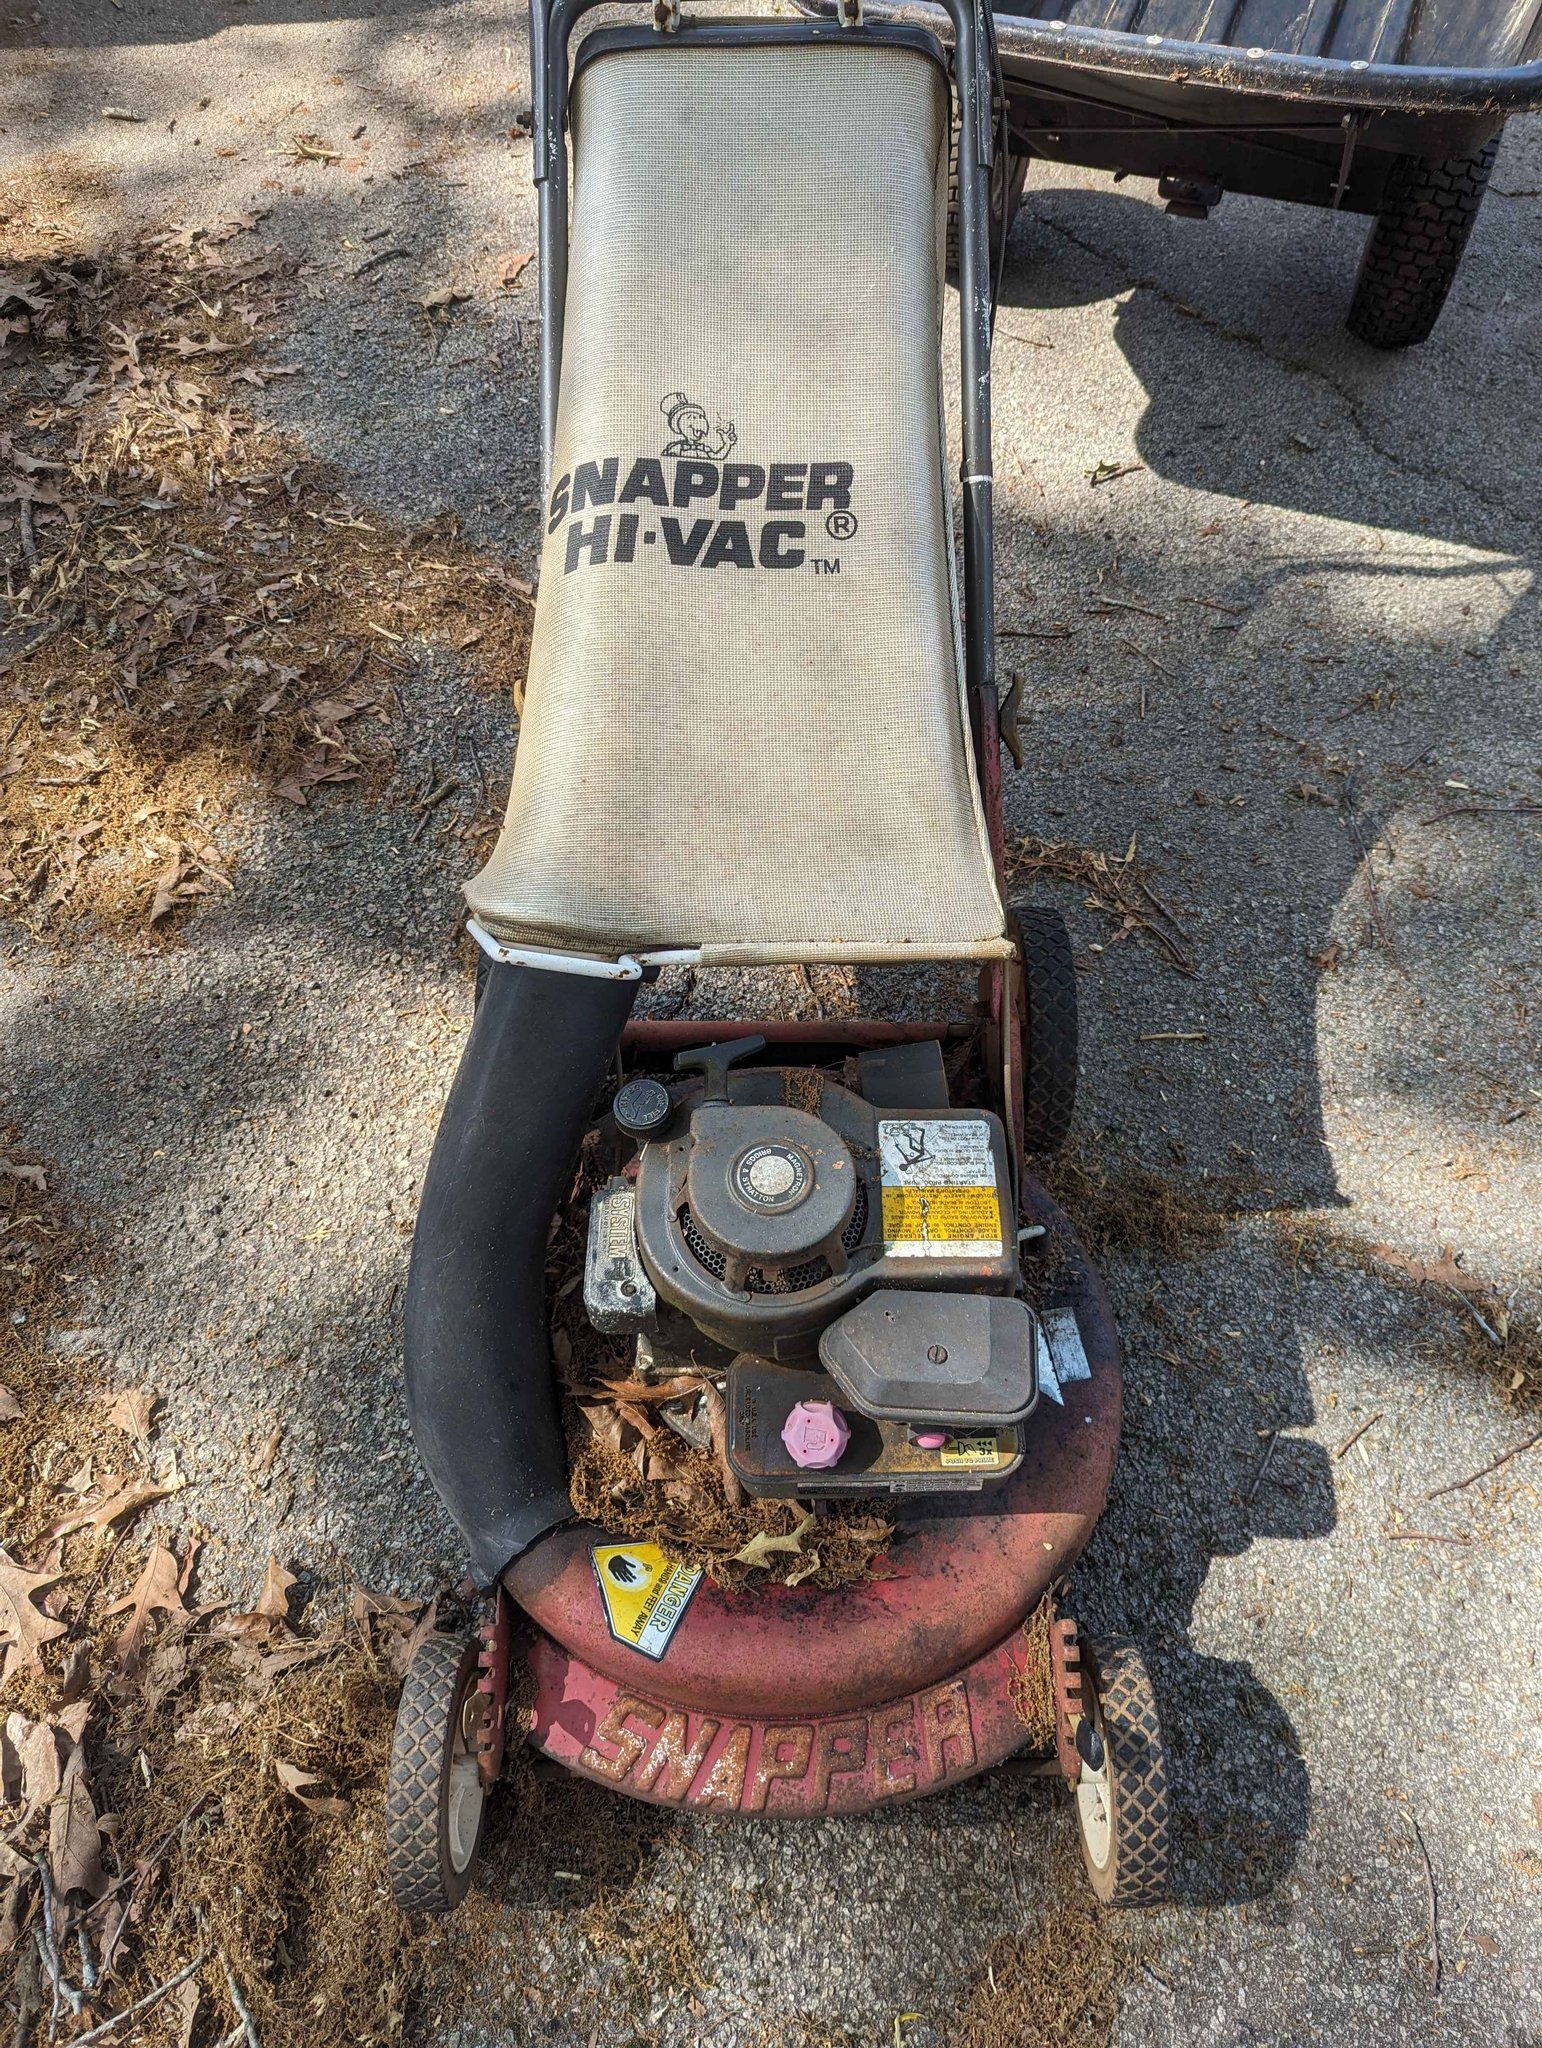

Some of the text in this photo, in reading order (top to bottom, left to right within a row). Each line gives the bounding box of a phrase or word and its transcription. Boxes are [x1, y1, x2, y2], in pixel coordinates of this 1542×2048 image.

[549, 457, 854, 535] SNAPPER
[642, 1107, 661, 1121] FILL
[745, 1148, 772, 1166] BRIGGS
[785, 1153, 803, 1196] MAGNETRON
[742, 1176, 775, 1203] STRATTON
[607, 1196, 631, 1259] SYSTEM
[974, 1456, 995, 1464] PRIME
[631, 1562, 676, 1637] HANDS and FEET AWAY
[650, 1564, 700, 1632] DANGER
[578, 1678, 979, 1813] SNAPPER
